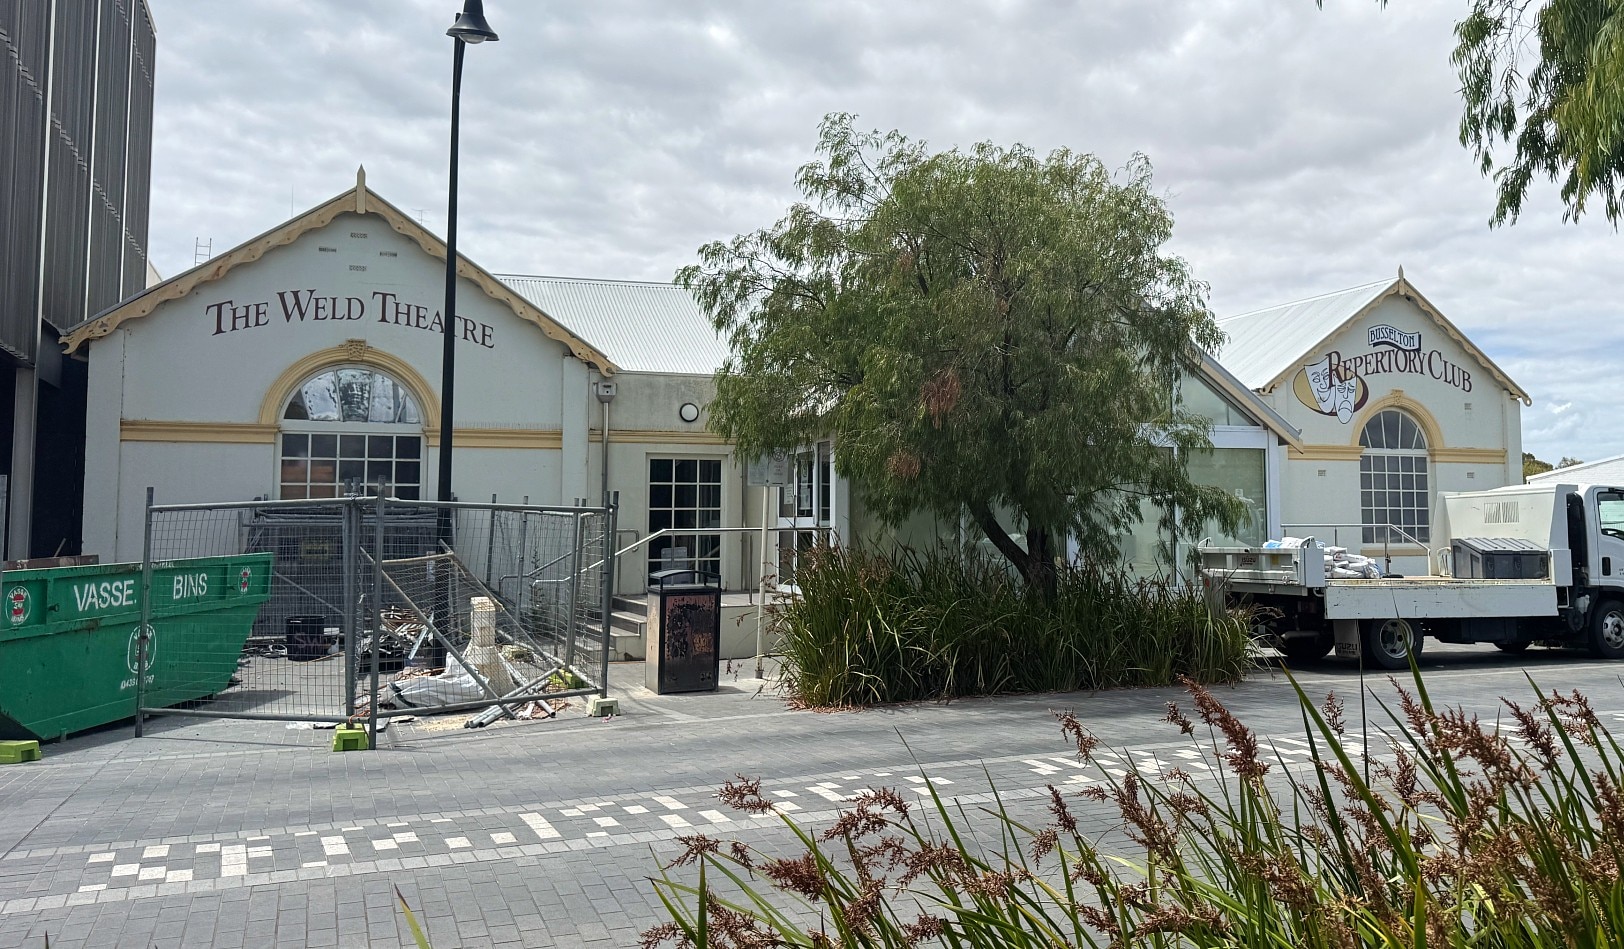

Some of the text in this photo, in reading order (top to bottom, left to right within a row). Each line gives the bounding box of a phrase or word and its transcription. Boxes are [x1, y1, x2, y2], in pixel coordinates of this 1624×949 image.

[205, 300, 270, 337] THE
[276, 289, 365, 324] WELD
[1370, 326, 1416, 348] BUSSELTON
[1325, 350, 1472, 393] REPERTORY CLUB
[173, 573, 208, 600] BINS
